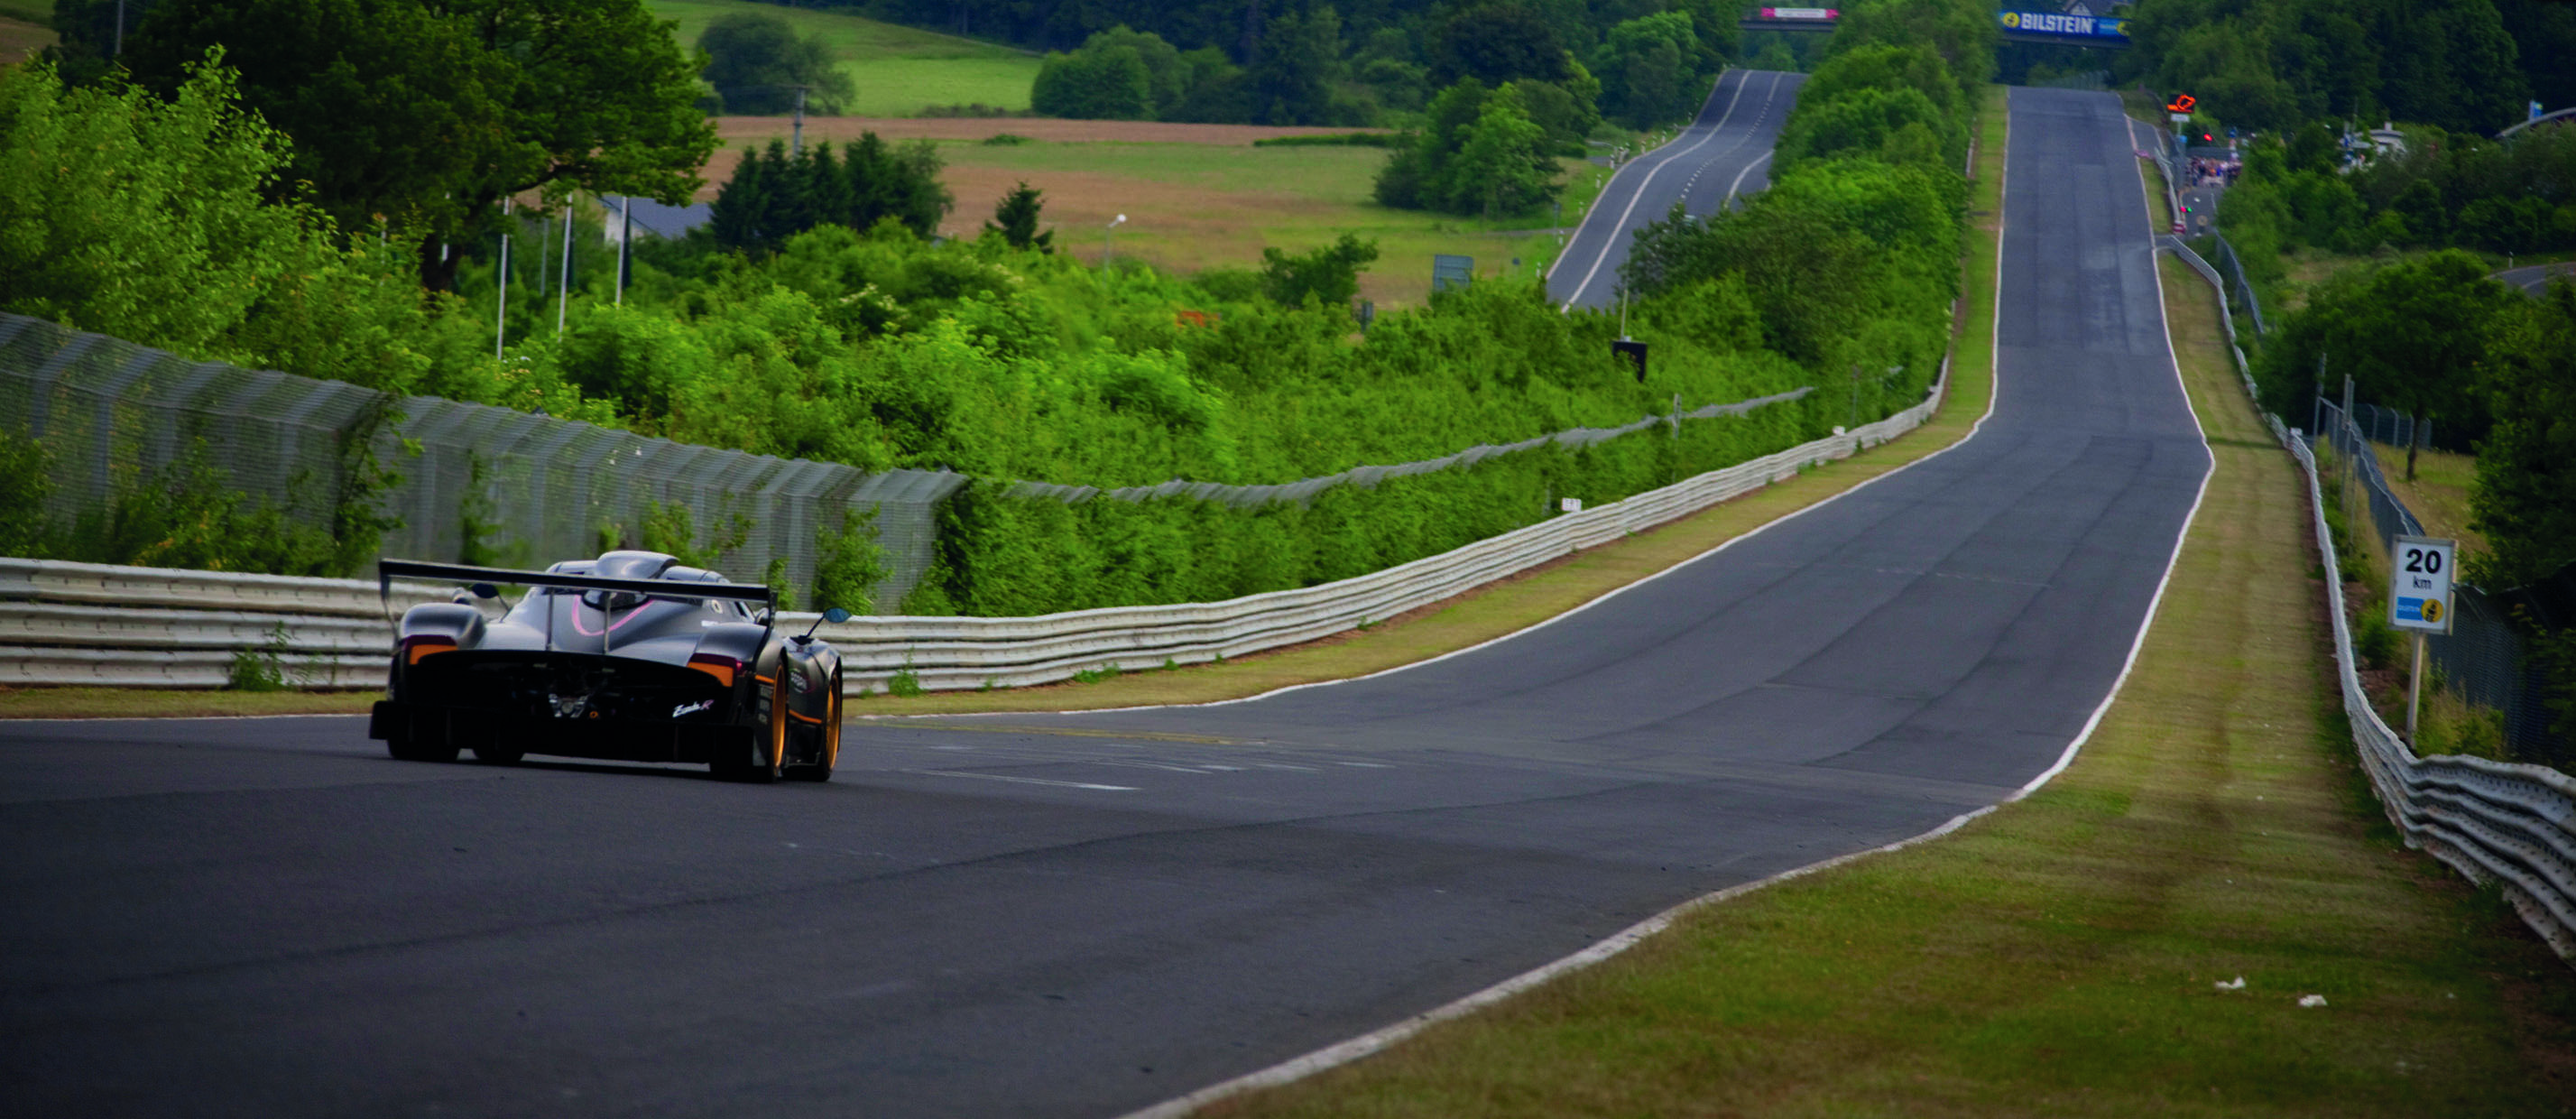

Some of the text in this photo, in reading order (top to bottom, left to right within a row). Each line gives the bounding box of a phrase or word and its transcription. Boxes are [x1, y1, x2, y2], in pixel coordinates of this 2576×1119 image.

[2020, 12, 2092, 34] BILSTEIN
[2405, 549, 2442, 574] 20
[2413, 575, 2433, 590] km
